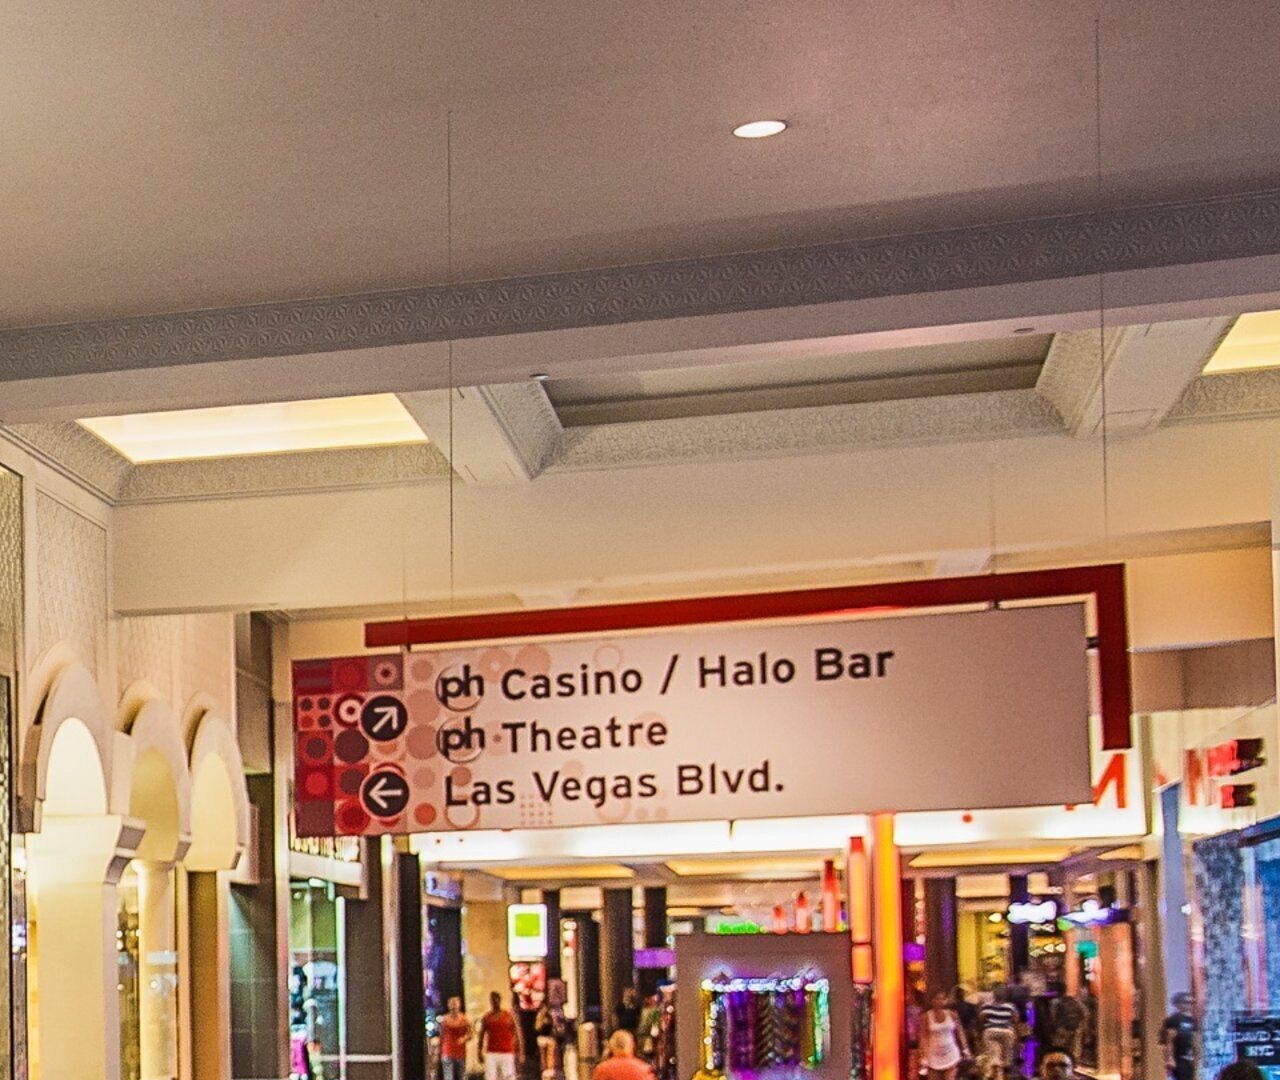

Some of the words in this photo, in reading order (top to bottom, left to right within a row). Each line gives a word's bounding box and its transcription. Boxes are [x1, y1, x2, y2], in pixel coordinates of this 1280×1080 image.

[439, 662, 485, 709] ph
[501, 663, 643, 701] Casino
[659, 654, 680, 696] /
[698, 651, 796, 688] Halo
[814, 647, 895, 682] Bar
[440, 716, 486, 760] ph
[501, 716, 668, 753] Theatre
[444, 774, 516, 806] Las
[532, 769, 658, 809] Vegas
[676, 758, 785, 797] Blvd.
